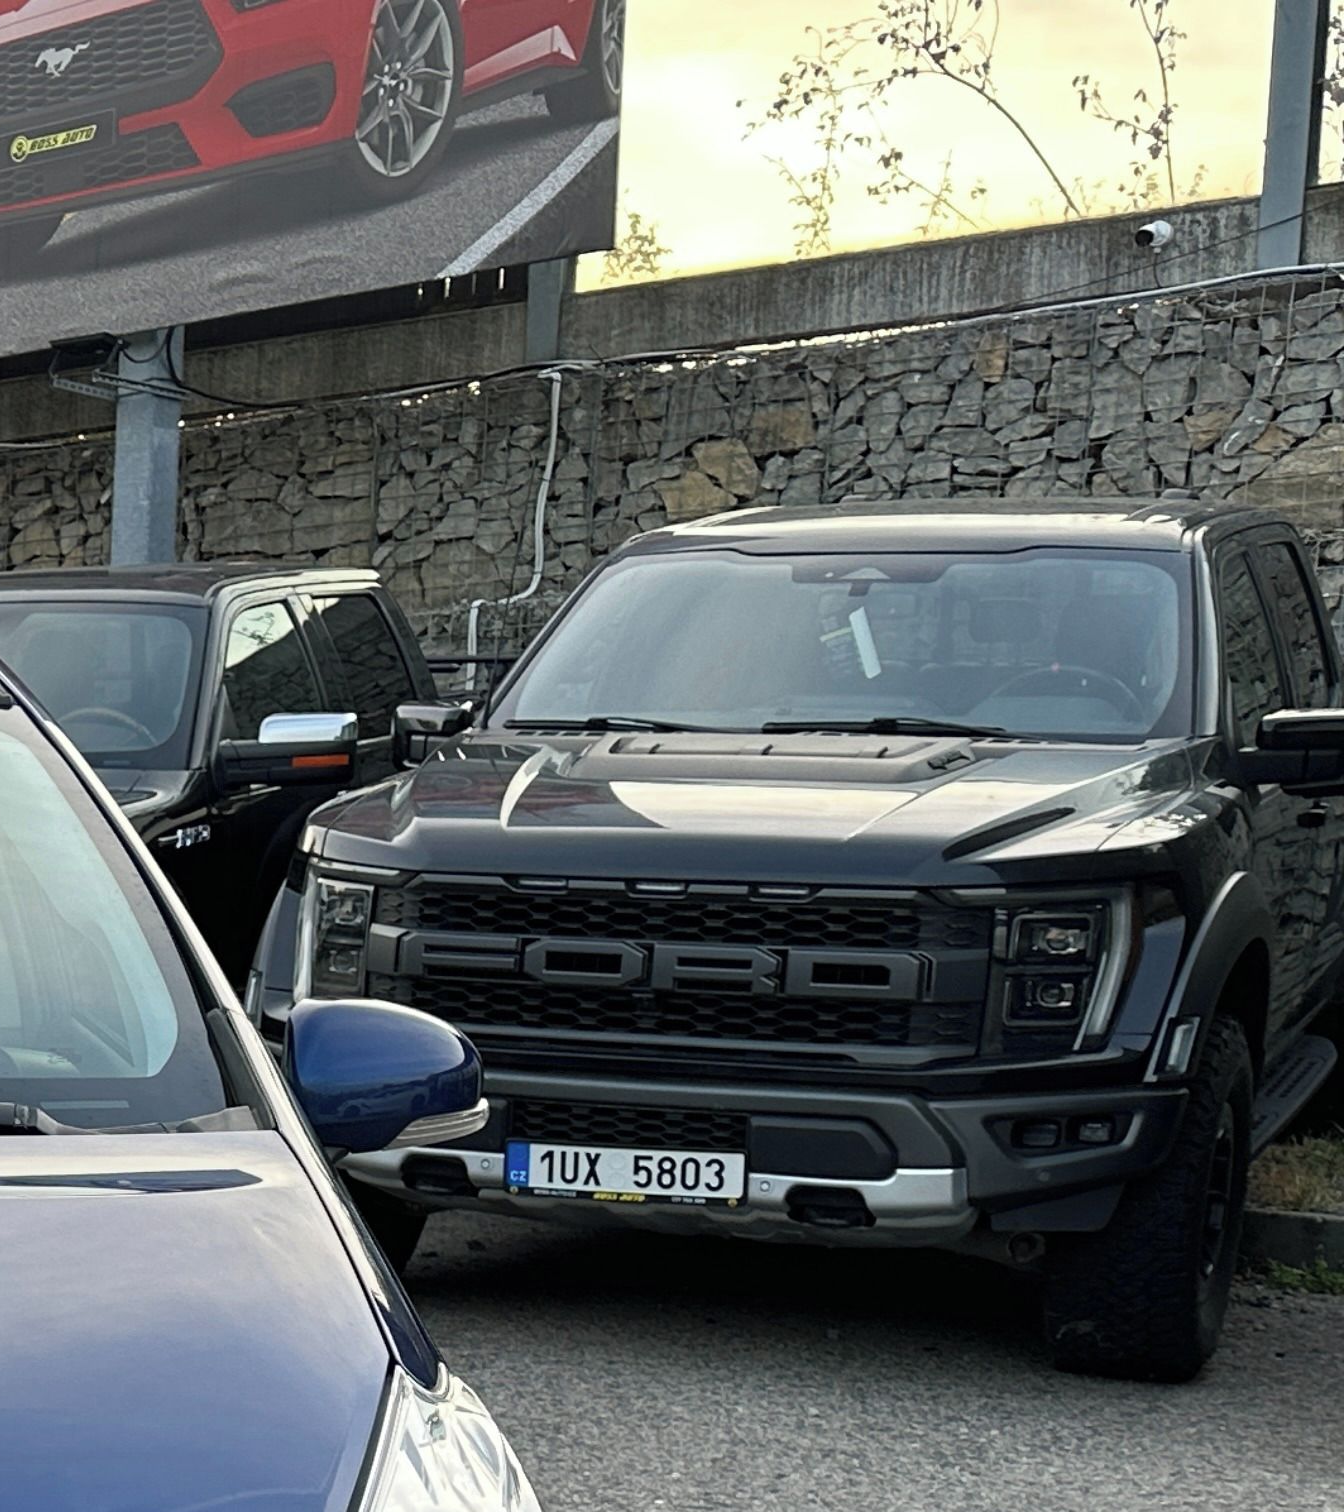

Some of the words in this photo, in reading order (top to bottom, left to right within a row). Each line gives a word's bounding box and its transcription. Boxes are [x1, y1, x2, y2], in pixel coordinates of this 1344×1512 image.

[404, 931, 934, 1000] FORD
[510, 1169, 527, 1182] CZ
[540, 1150, 602, 1187] 1UX
[633, 1154, 726, 1192] 5803
